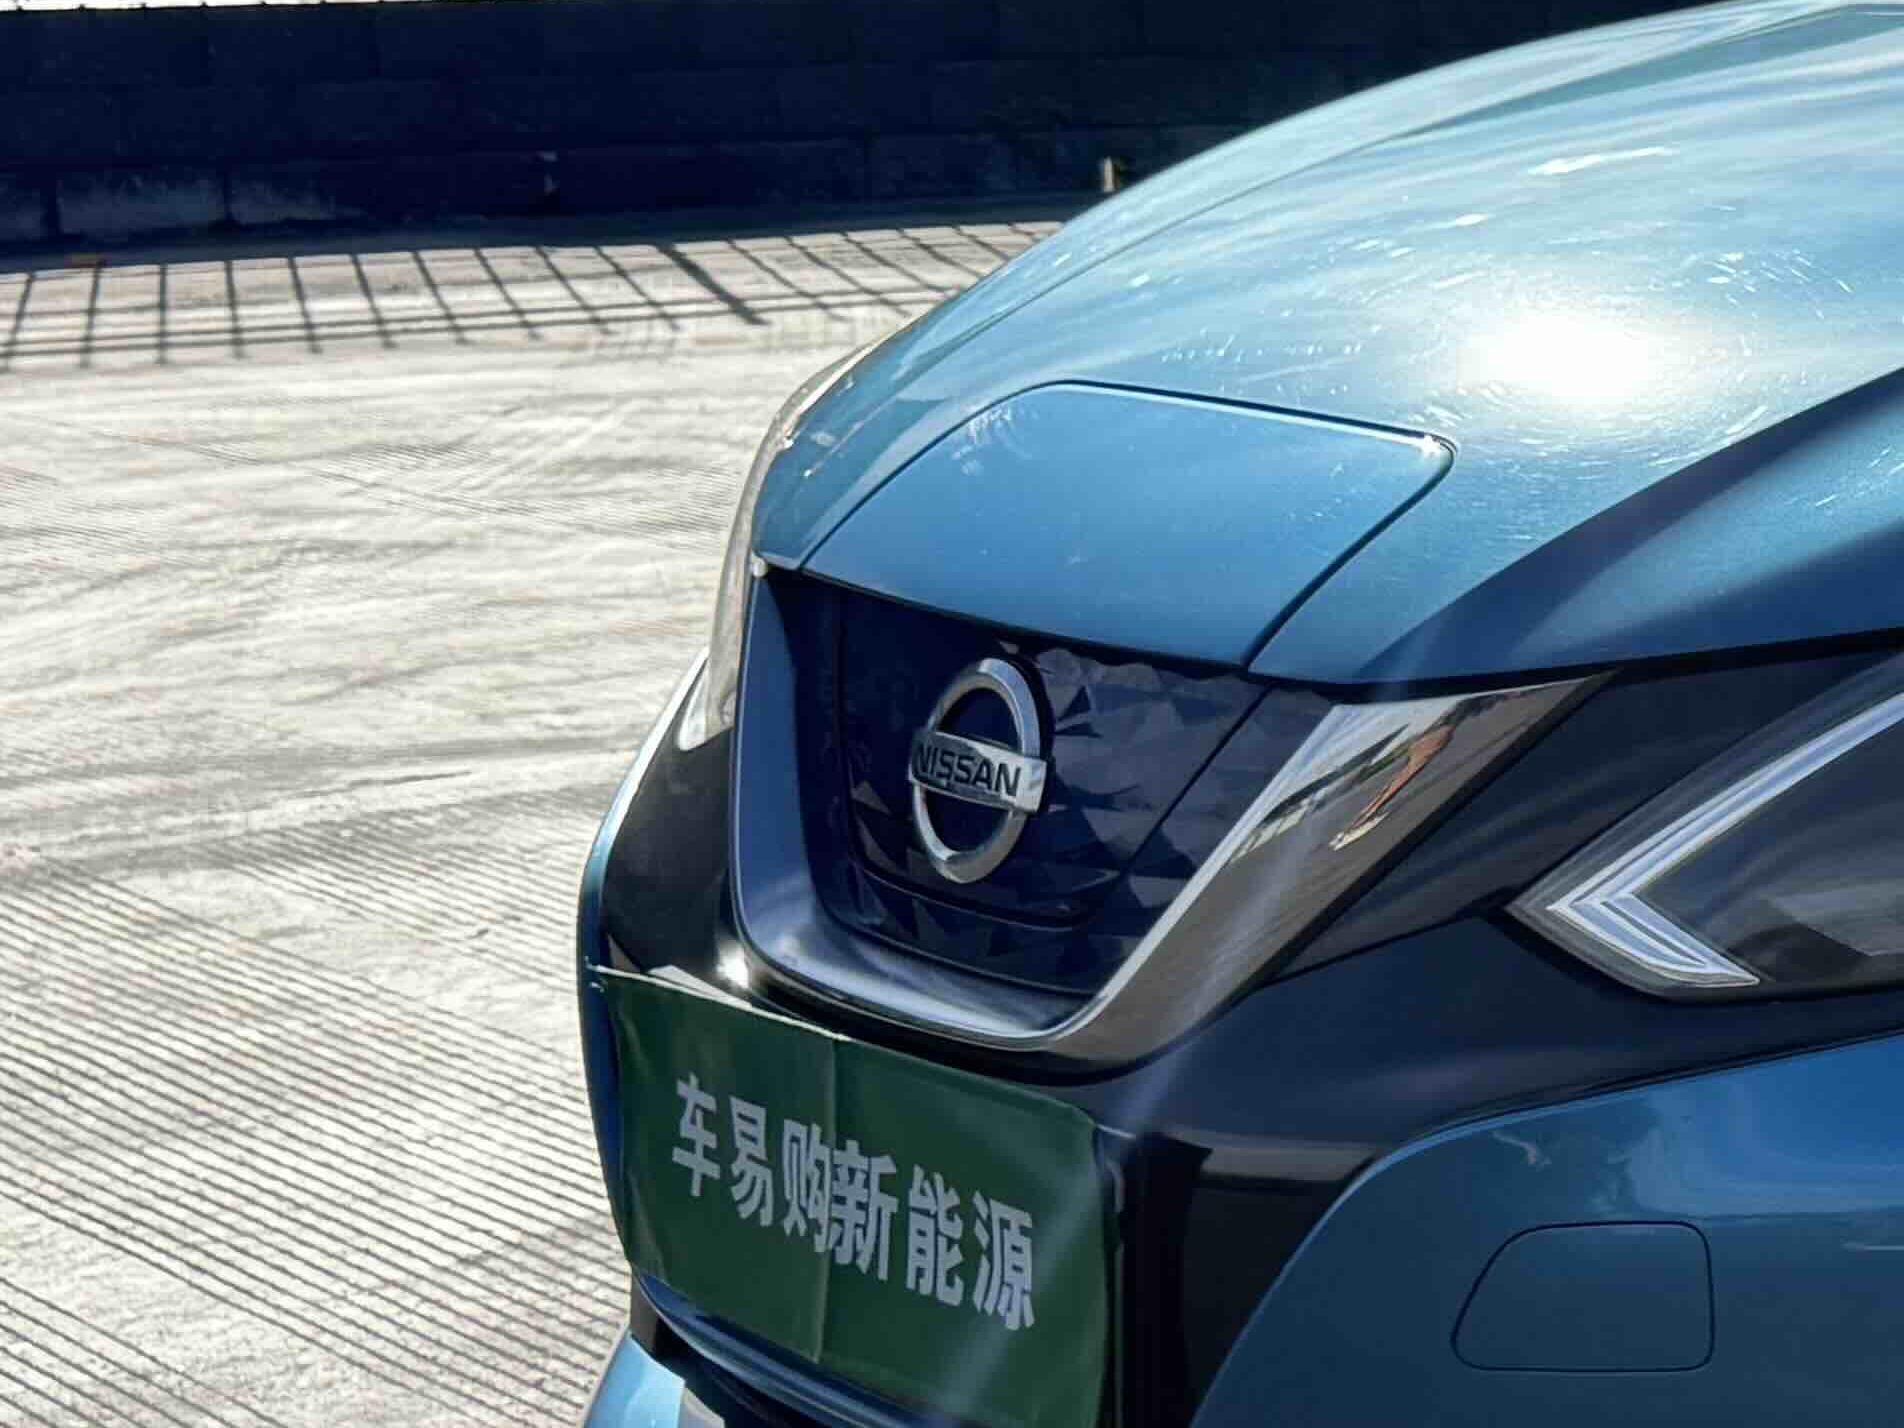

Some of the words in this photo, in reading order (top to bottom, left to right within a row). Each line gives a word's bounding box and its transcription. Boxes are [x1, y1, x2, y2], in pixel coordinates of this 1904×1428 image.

[912, 742, 1022, 798] NISSAN
[671, 1071, 1035, 1331] 车易购新能源
